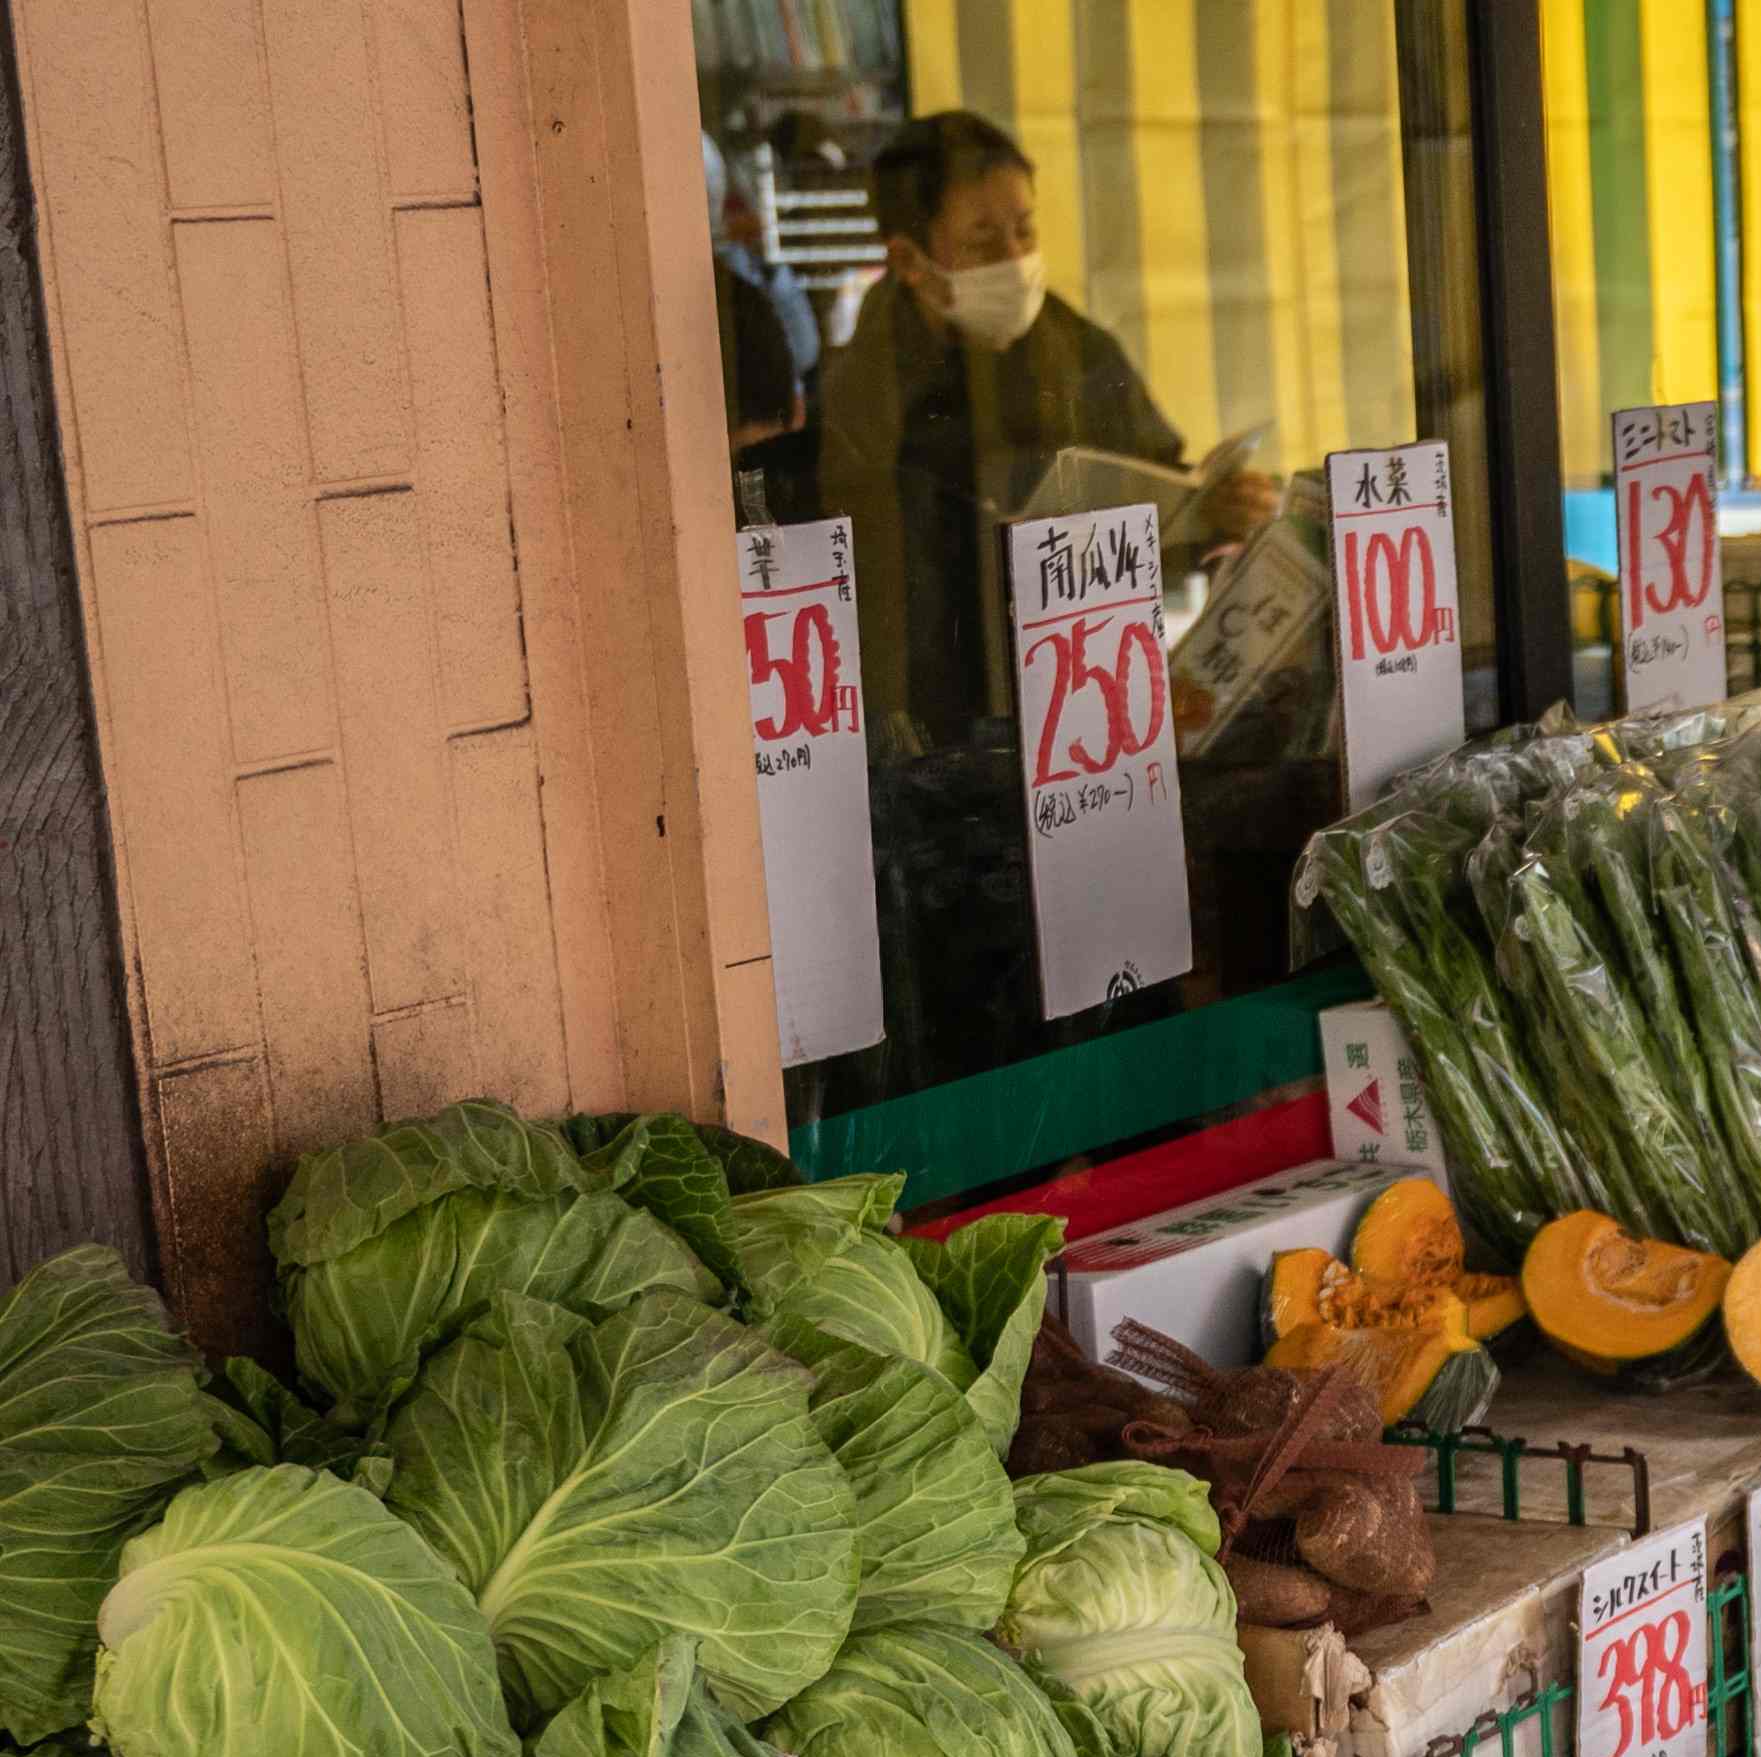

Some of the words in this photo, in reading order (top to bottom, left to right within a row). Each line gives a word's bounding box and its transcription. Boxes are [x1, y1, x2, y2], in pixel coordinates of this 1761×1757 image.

[1355, 457, 1412, 508] 水菜
[1344, 526, 1454, 660] 100円
[1024, 617, 1168, 788] 250
